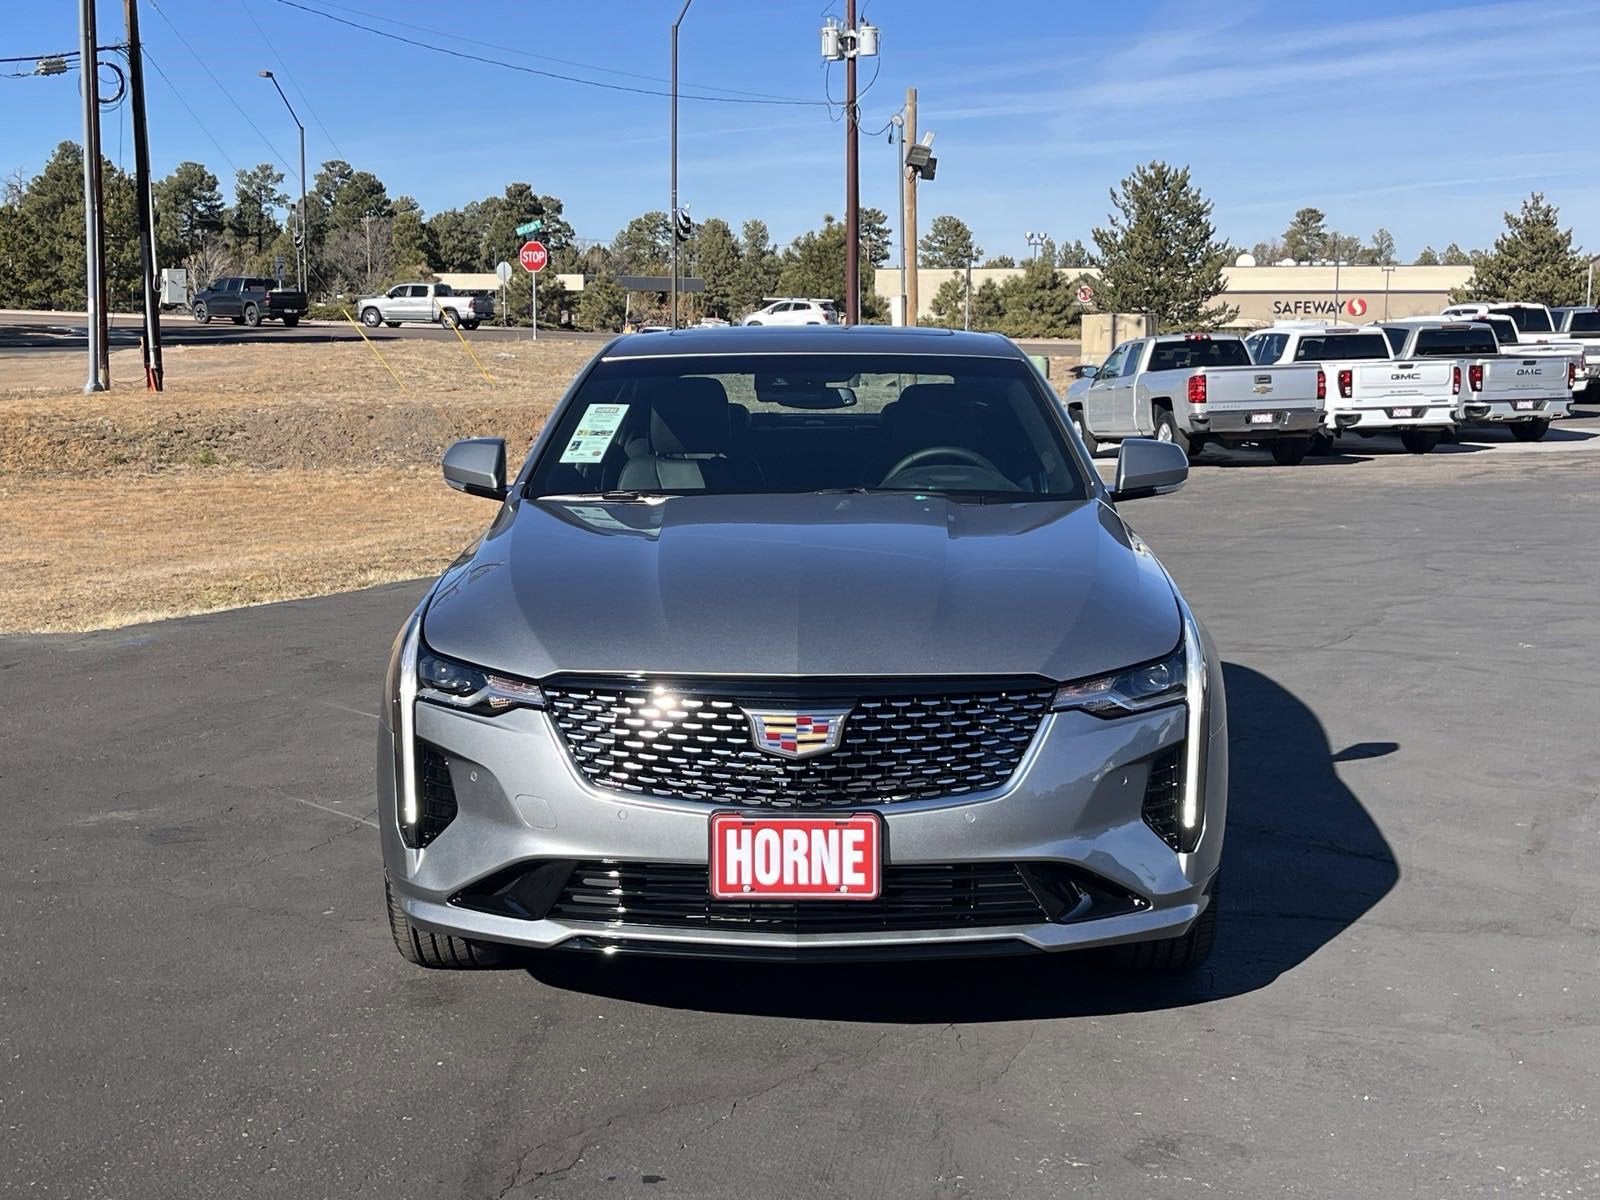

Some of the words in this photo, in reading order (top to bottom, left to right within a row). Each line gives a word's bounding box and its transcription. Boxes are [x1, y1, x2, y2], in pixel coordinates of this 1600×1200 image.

[522, 251, 545, 262] STOP
[1273, 301, 1346, 314] SAFEWAY
[1252, 414, 1273, 423] HORNE
[726, 828, 865, 886] HORNE
